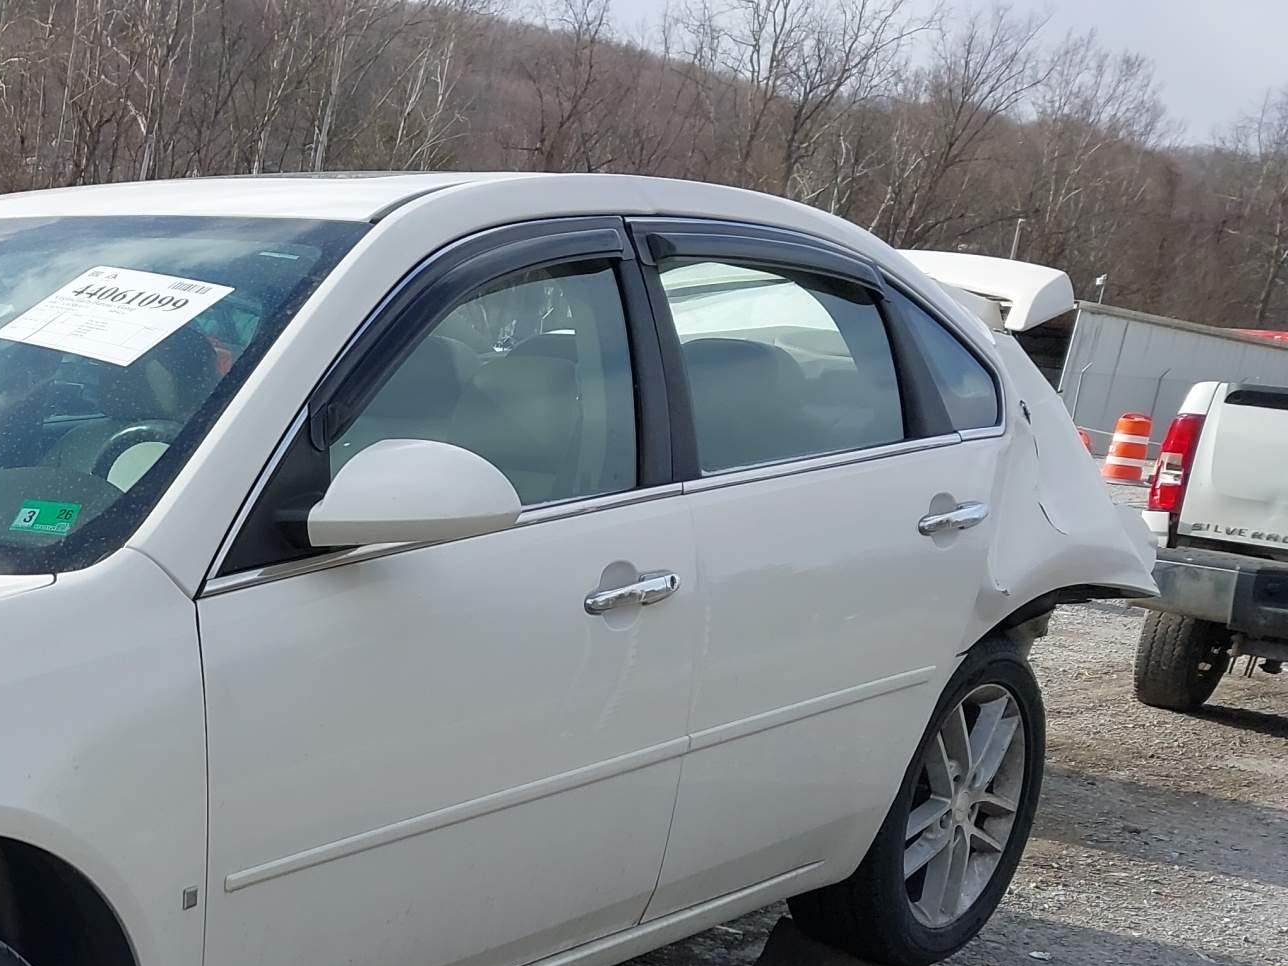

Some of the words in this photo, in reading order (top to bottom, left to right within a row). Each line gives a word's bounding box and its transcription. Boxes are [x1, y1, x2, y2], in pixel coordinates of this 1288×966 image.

[72, 283, 189, 312] 44061099
[23, 510, 36, 523] 3
[56, 509, 74, 520] 26
